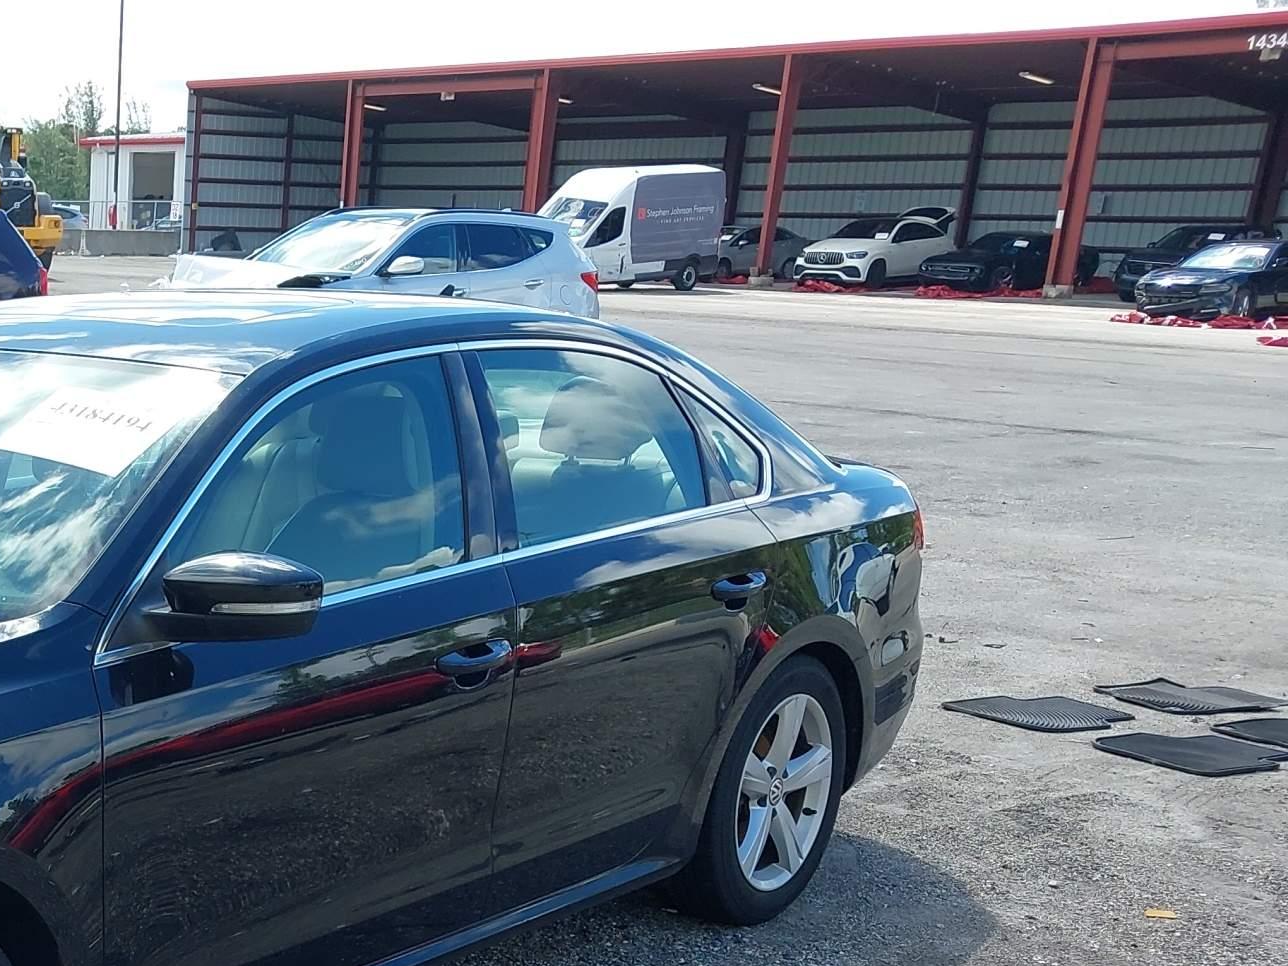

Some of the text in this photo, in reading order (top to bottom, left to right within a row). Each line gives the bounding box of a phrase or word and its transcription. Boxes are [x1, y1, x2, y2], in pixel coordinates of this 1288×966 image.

[646, 204, 714, 218] Stephen Johnson Framing
